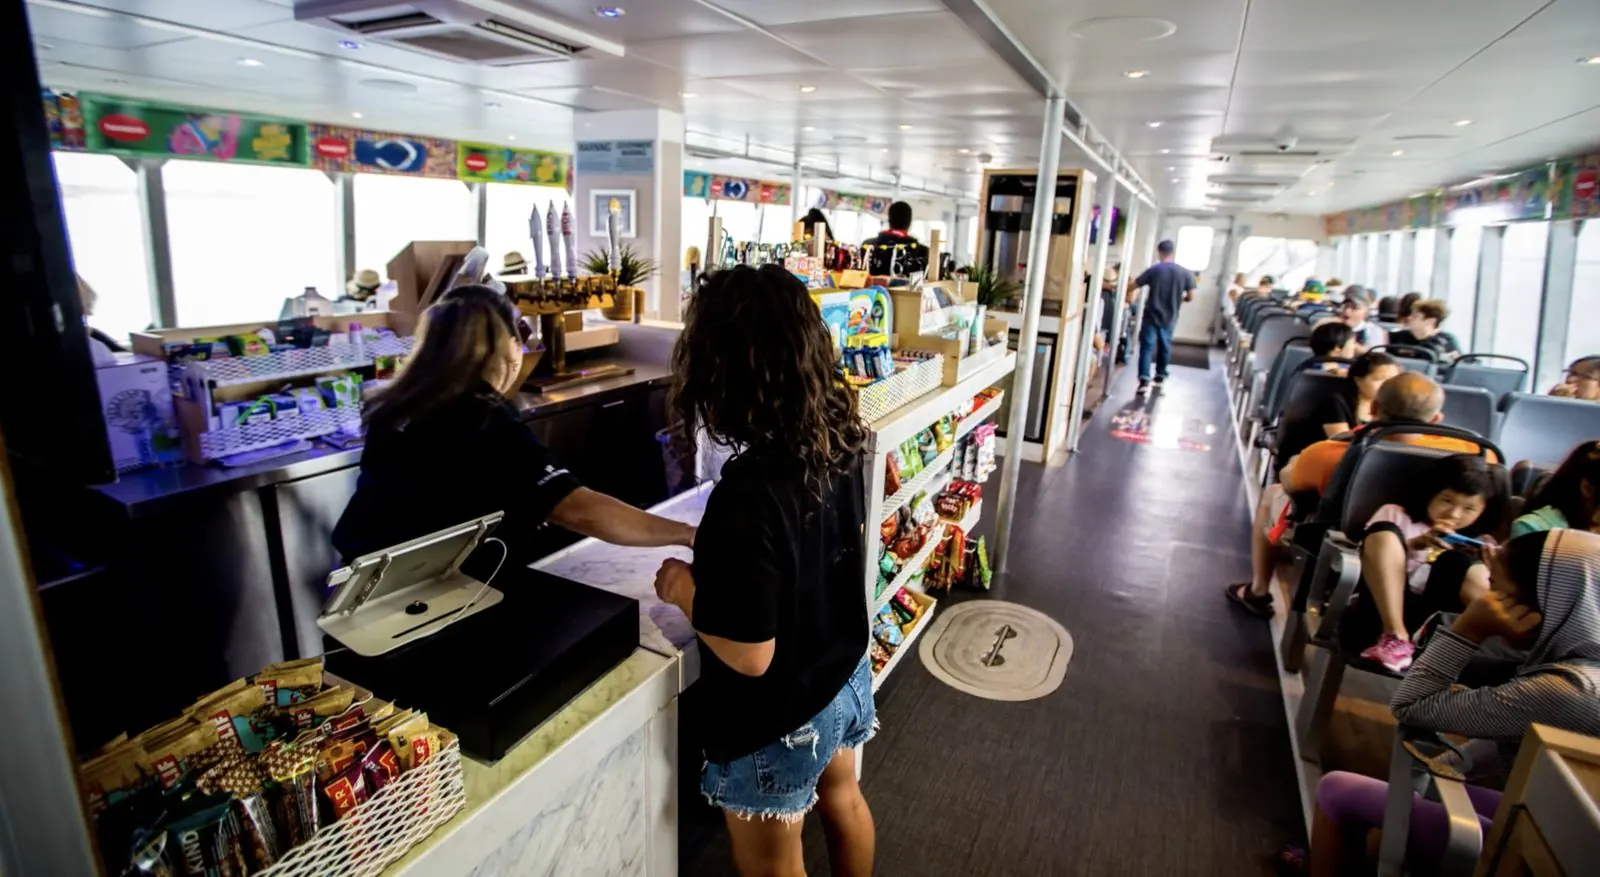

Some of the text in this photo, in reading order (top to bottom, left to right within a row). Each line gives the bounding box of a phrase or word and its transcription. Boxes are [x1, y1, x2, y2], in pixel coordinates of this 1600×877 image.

[261, 684, 276, 706] LIF
[157, 761, 180, 788] LIF
[181, 829, 205, 875] KIND
